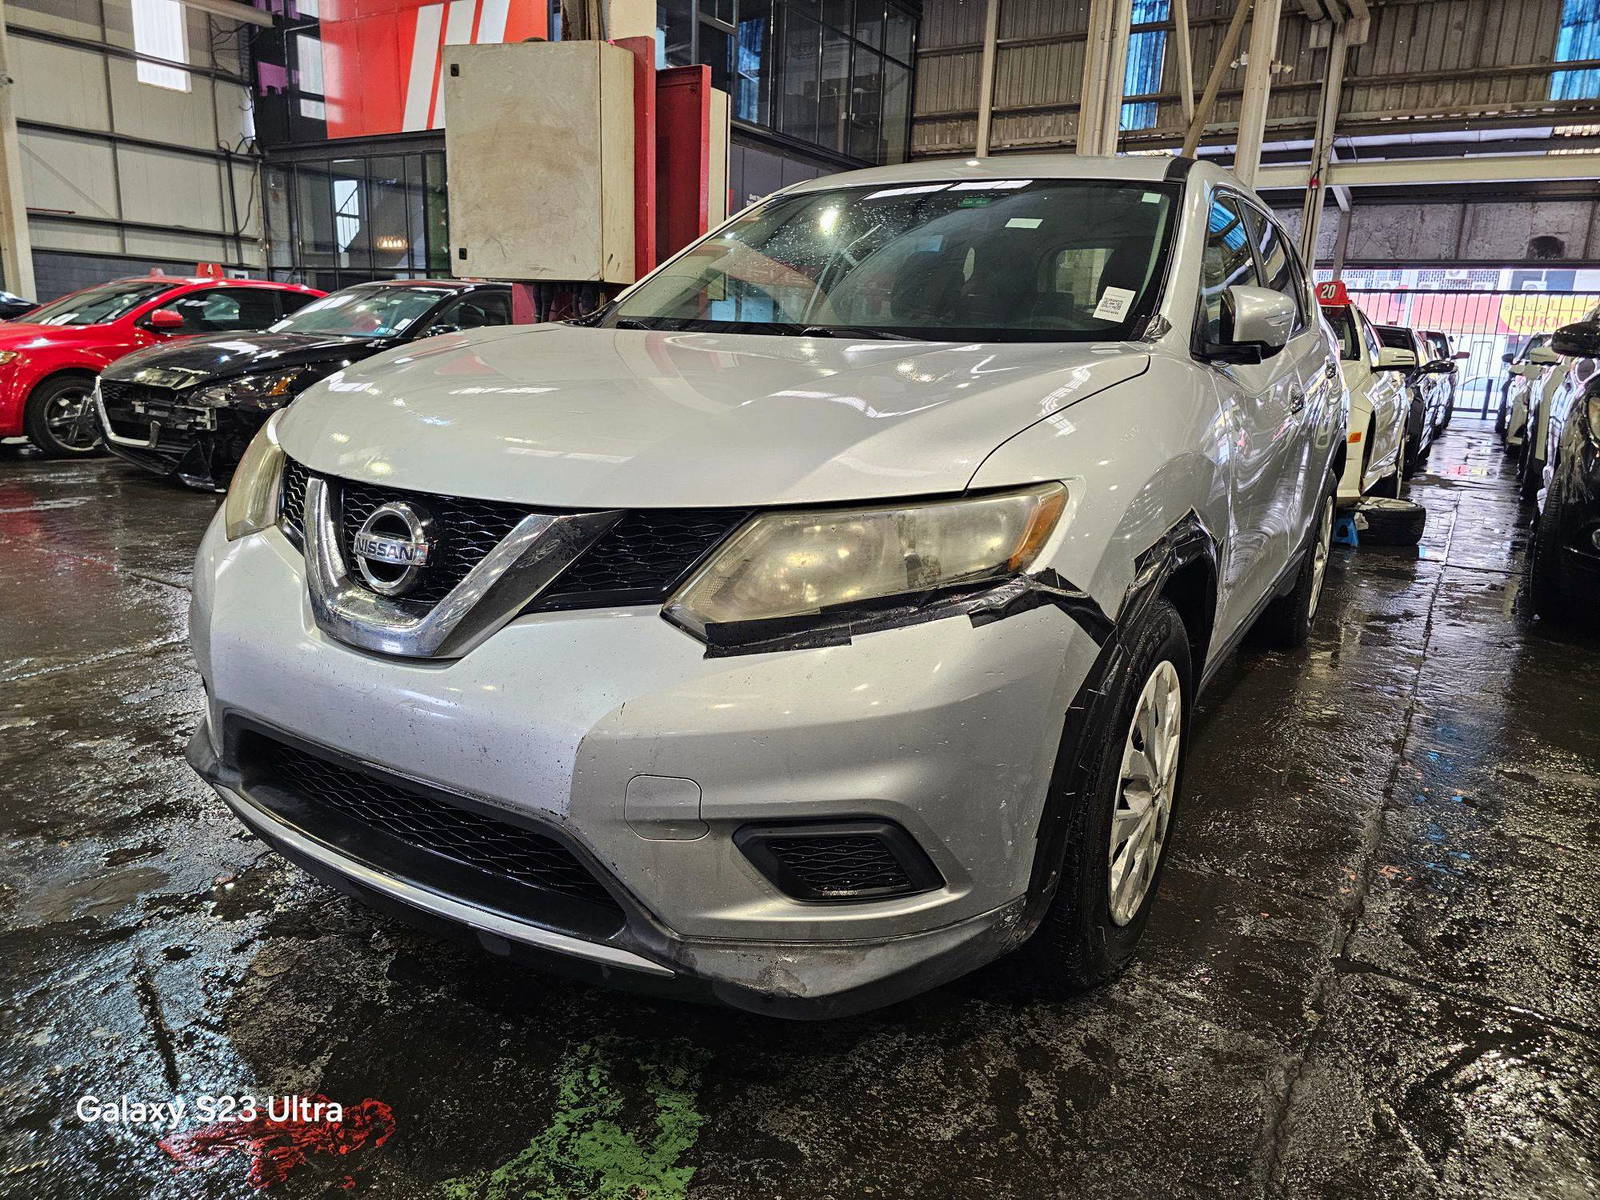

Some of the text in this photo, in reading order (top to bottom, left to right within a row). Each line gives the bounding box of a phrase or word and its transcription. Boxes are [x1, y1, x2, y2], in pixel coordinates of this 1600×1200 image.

[1320, 284, 1337, 299] 20
[1513, 315, 1565, 328] RUKN
[356, 537, 416, 561] NISSAN
